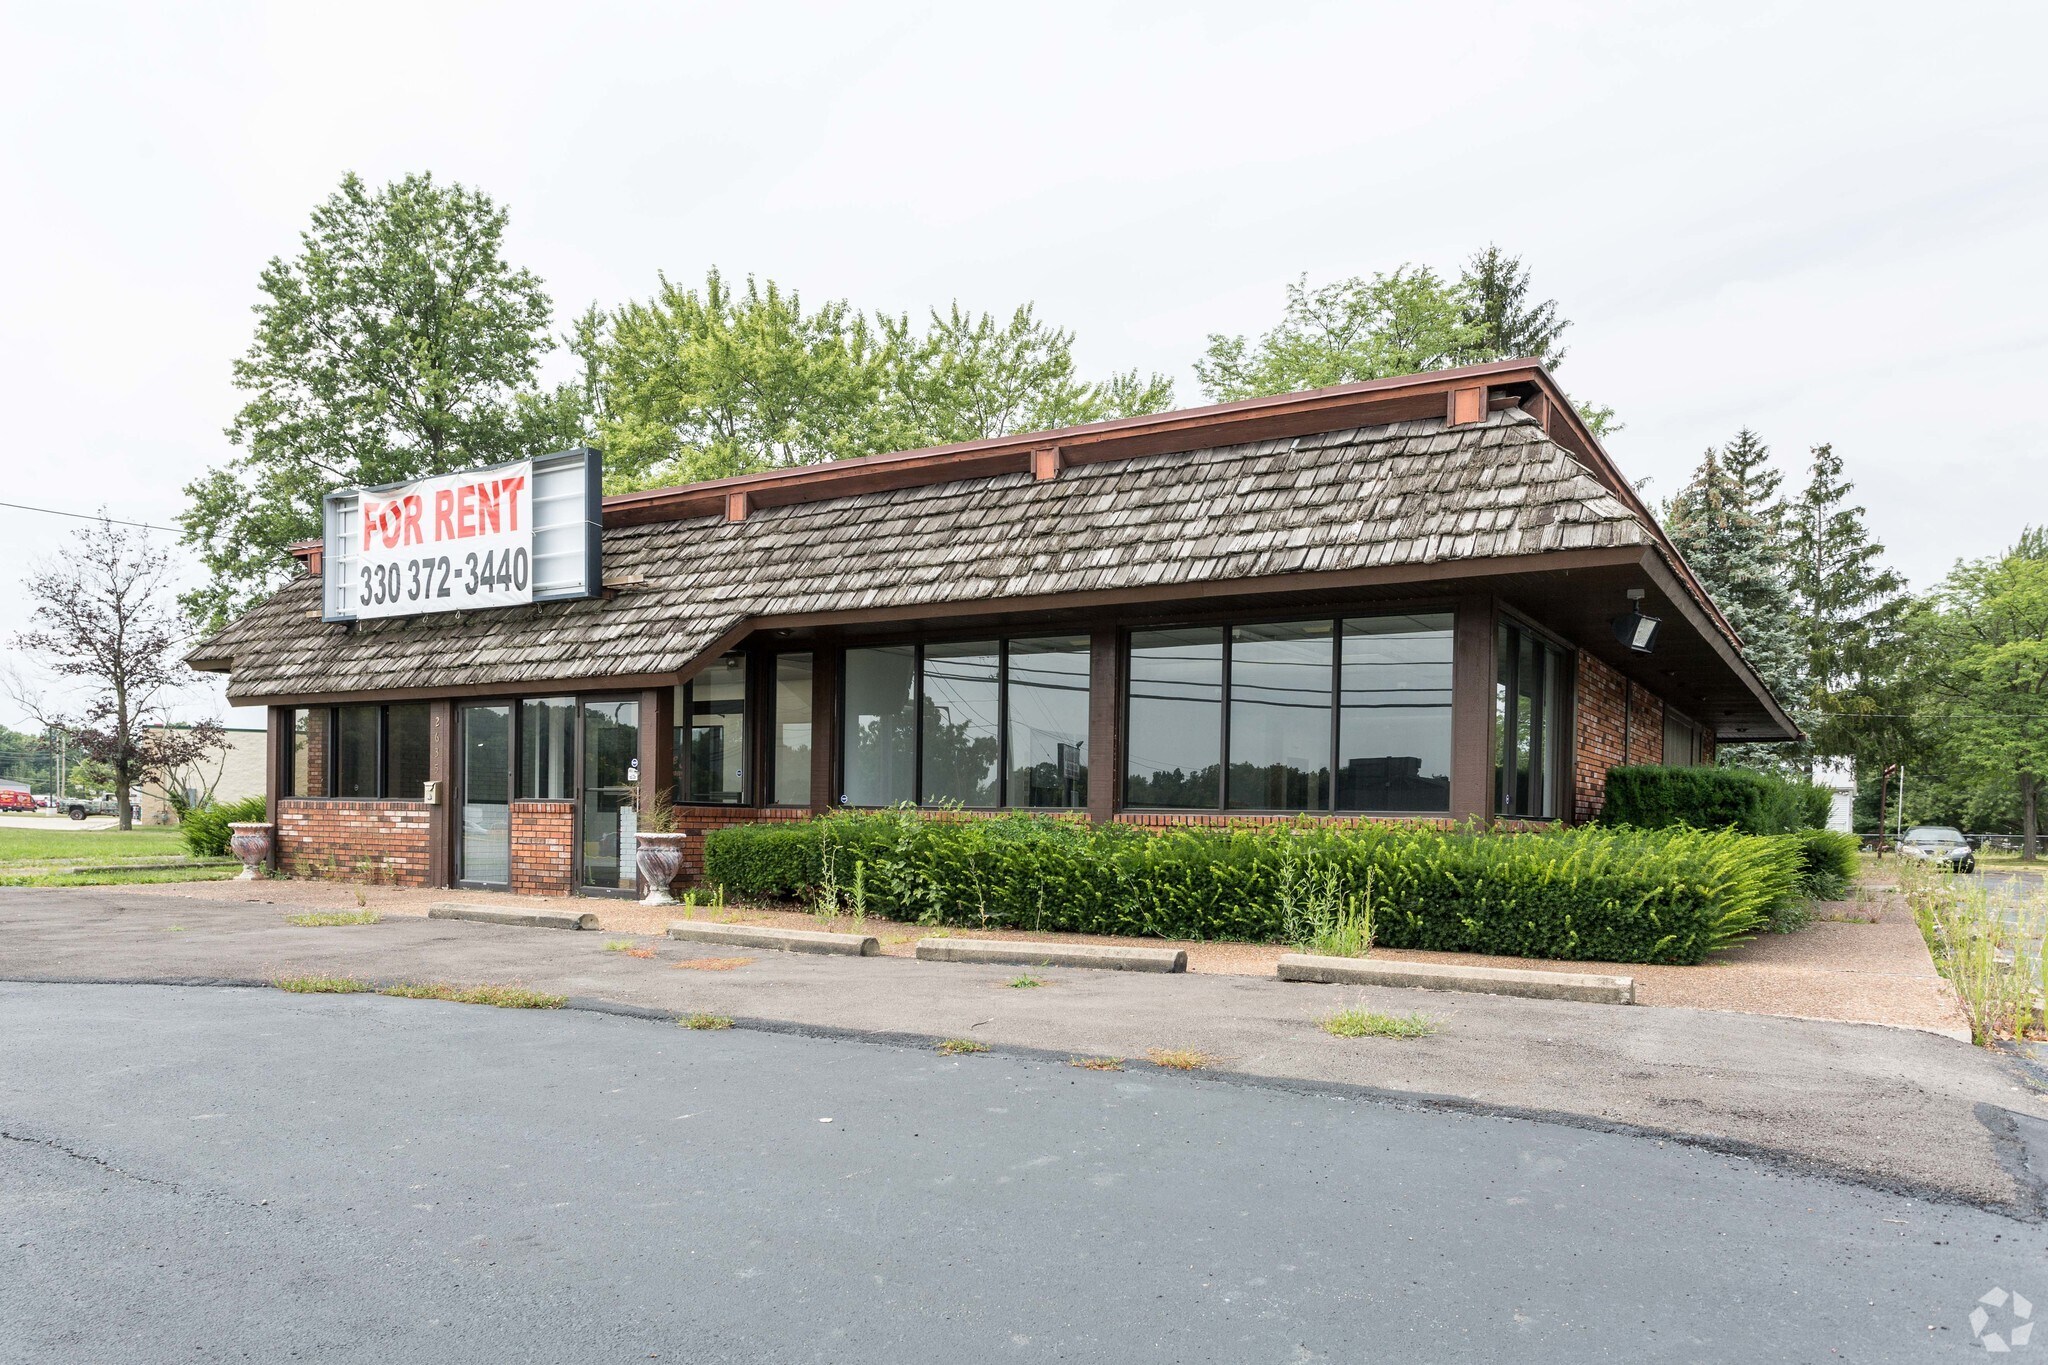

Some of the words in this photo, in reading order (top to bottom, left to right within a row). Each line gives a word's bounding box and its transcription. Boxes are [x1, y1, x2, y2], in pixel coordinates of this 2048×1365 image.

[363, 495, 424, 551] FOR
[435, 476, 524, 542] RENT
[360, 562, 401, 606] 330
[407, 546, 528, 601] 372-3440
